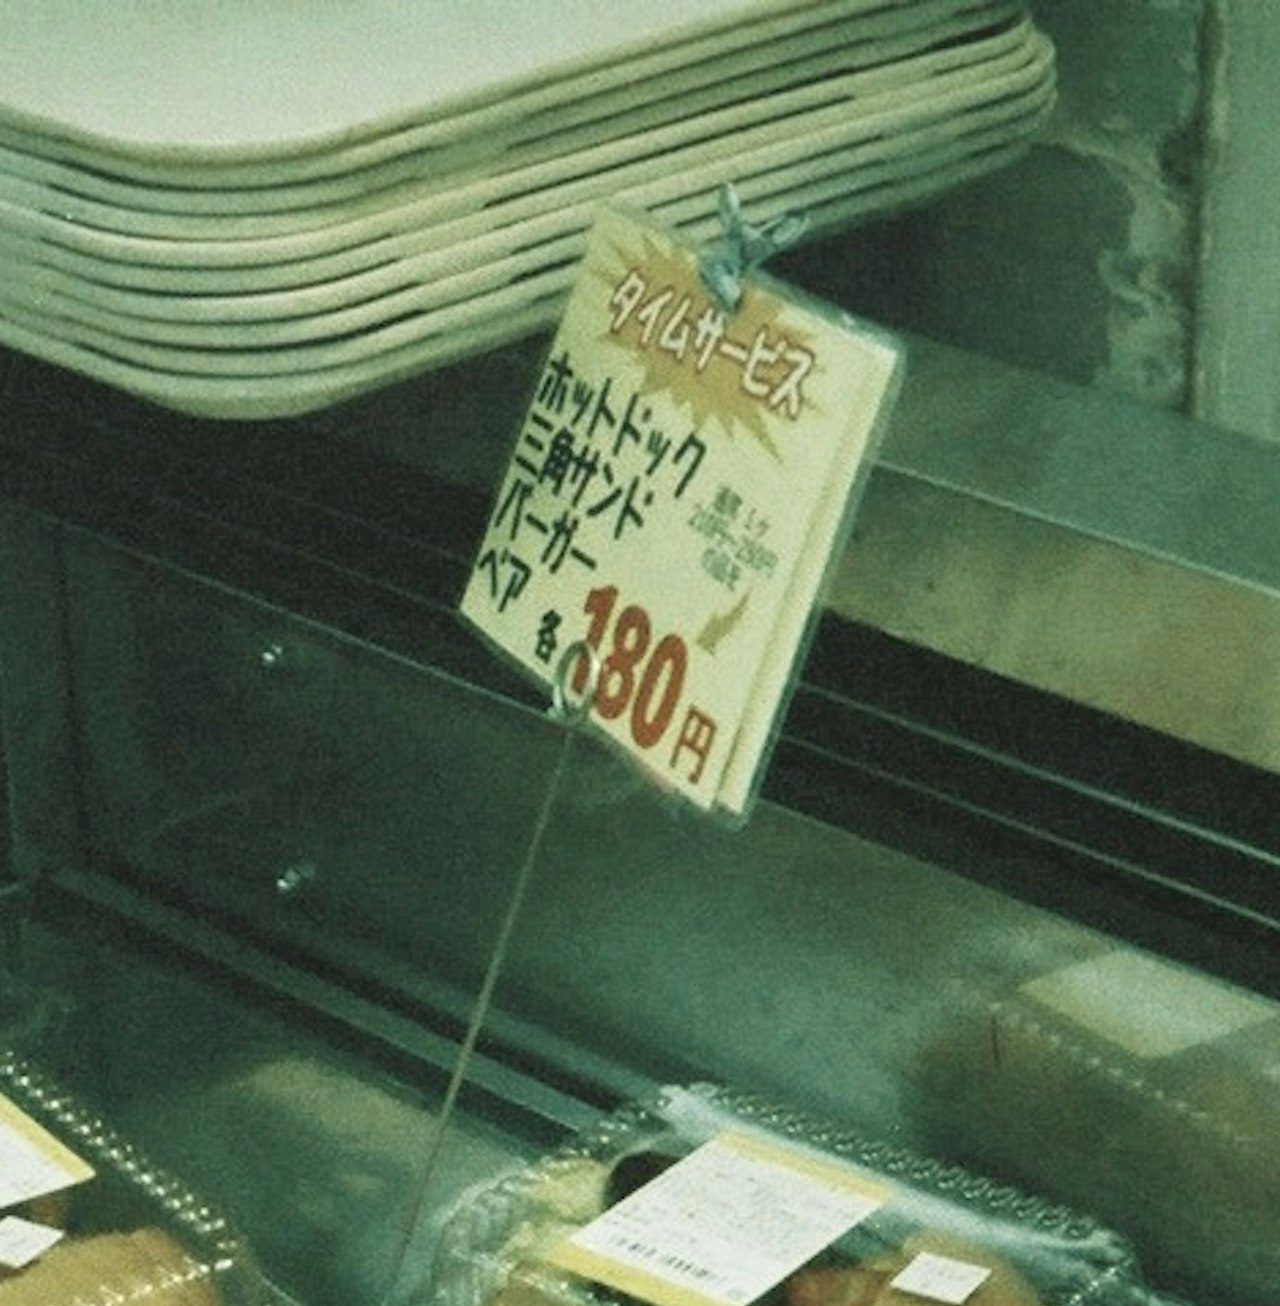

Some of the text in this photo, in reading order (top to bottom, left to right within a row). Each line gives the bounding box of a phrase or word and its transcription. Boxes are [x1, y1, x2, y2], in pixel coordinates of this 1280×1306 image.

[609, 268, 815, 420] タイムサービス
[515, 413, 654, 540] 三角サンド
